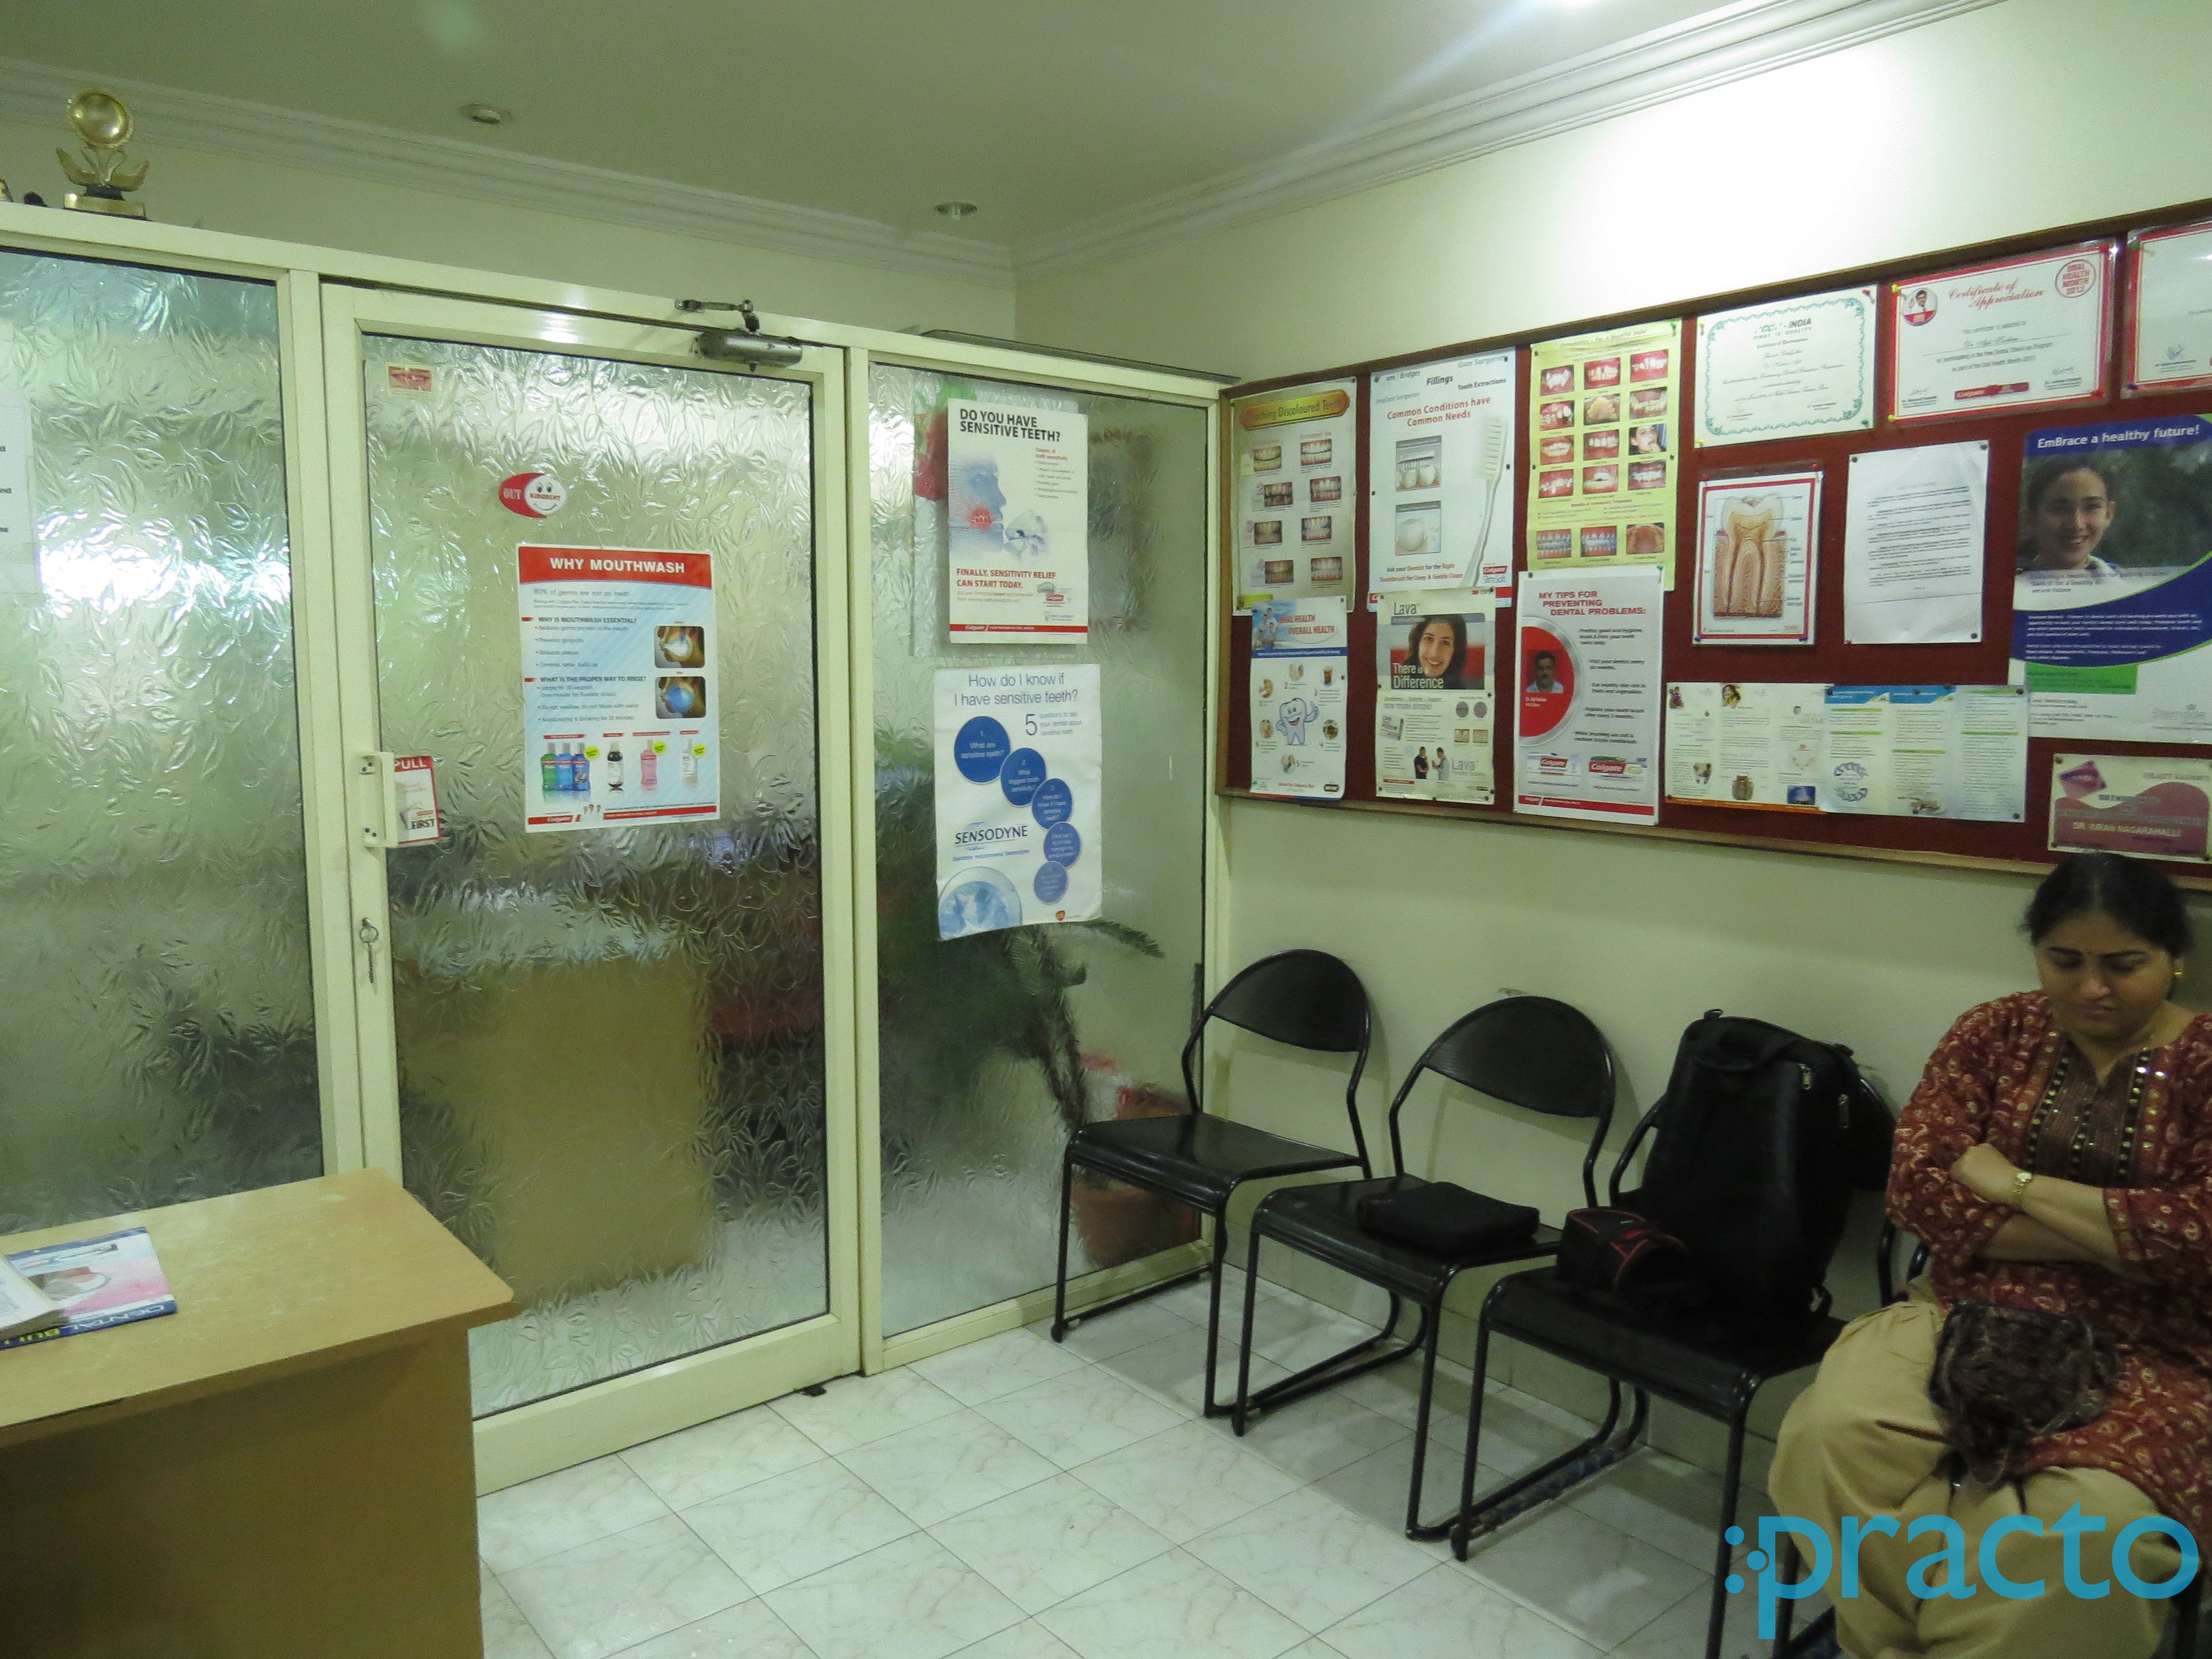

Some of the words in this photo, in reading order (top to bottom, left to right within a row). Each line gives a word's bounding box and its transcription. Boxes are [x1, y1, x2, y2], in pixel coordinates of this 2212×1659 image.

[1949, 284, 2003, 299] Certificate
[2005, 278, 2020, 291] of
[1969, 289, 2044, 311] Appreciation
[1788, 318, 1811, 328] INDIA
[1426, 375, 1453, 386] Fillings
[1278, 401, 1320, 417] Discoloured
[1387, 406, 1422, 420] Common
[1423, 399, 1469, 414] Conditions
[1470, 397, 1491, 407] have
[960, 409, 977, 421] DO
[980, 410, 1004, 424] YOU
[1007, 414, 1037, 428] HAVE
[1407, 415, 1443, 427] Common
[1445, 410, 1471, 421] Needs
[960, 421, 1018, 439] SENSITIVE
[1020, 427, 1061, 442] TEETH?
[2037, 436, 2088, 448] EmBrace
[2101, 429, 2150, 442] healthy
[2153, 424, 2200, 438] future!
[550, 557, 585, 570] WHY
[591, 559, 685, 573] MOUTHWASH
[990, 570, 1031, 578] SENSITIVITY
[1032, 571, 1056, 579] RELIEF
[1588, 607, 1647, 615] PROBLEMS:
[1392, 662, 1417, 676] There
[1417, 666, 1423, 675] is
[968, 674, 996, 688] How
[1000, 673, 1016, 686] do
[1019, 674, 1022, 686] I
[1026, 672, 1056, 685] know
[1058, 672, 1065, 685] if
[1394, 675, 1444, 690] Difference
[954, 694, 957, 706] I
[961, 692, 990, 706] have
[994, 691, 1042, 705] sensitive
[1045, 689, 1078, 703] teeth?
[1025, 713, 1038, 736] 5
[1590, 763, 1623, 772] Colgate
[954, 825, 1028, 844] SENSODYNE
